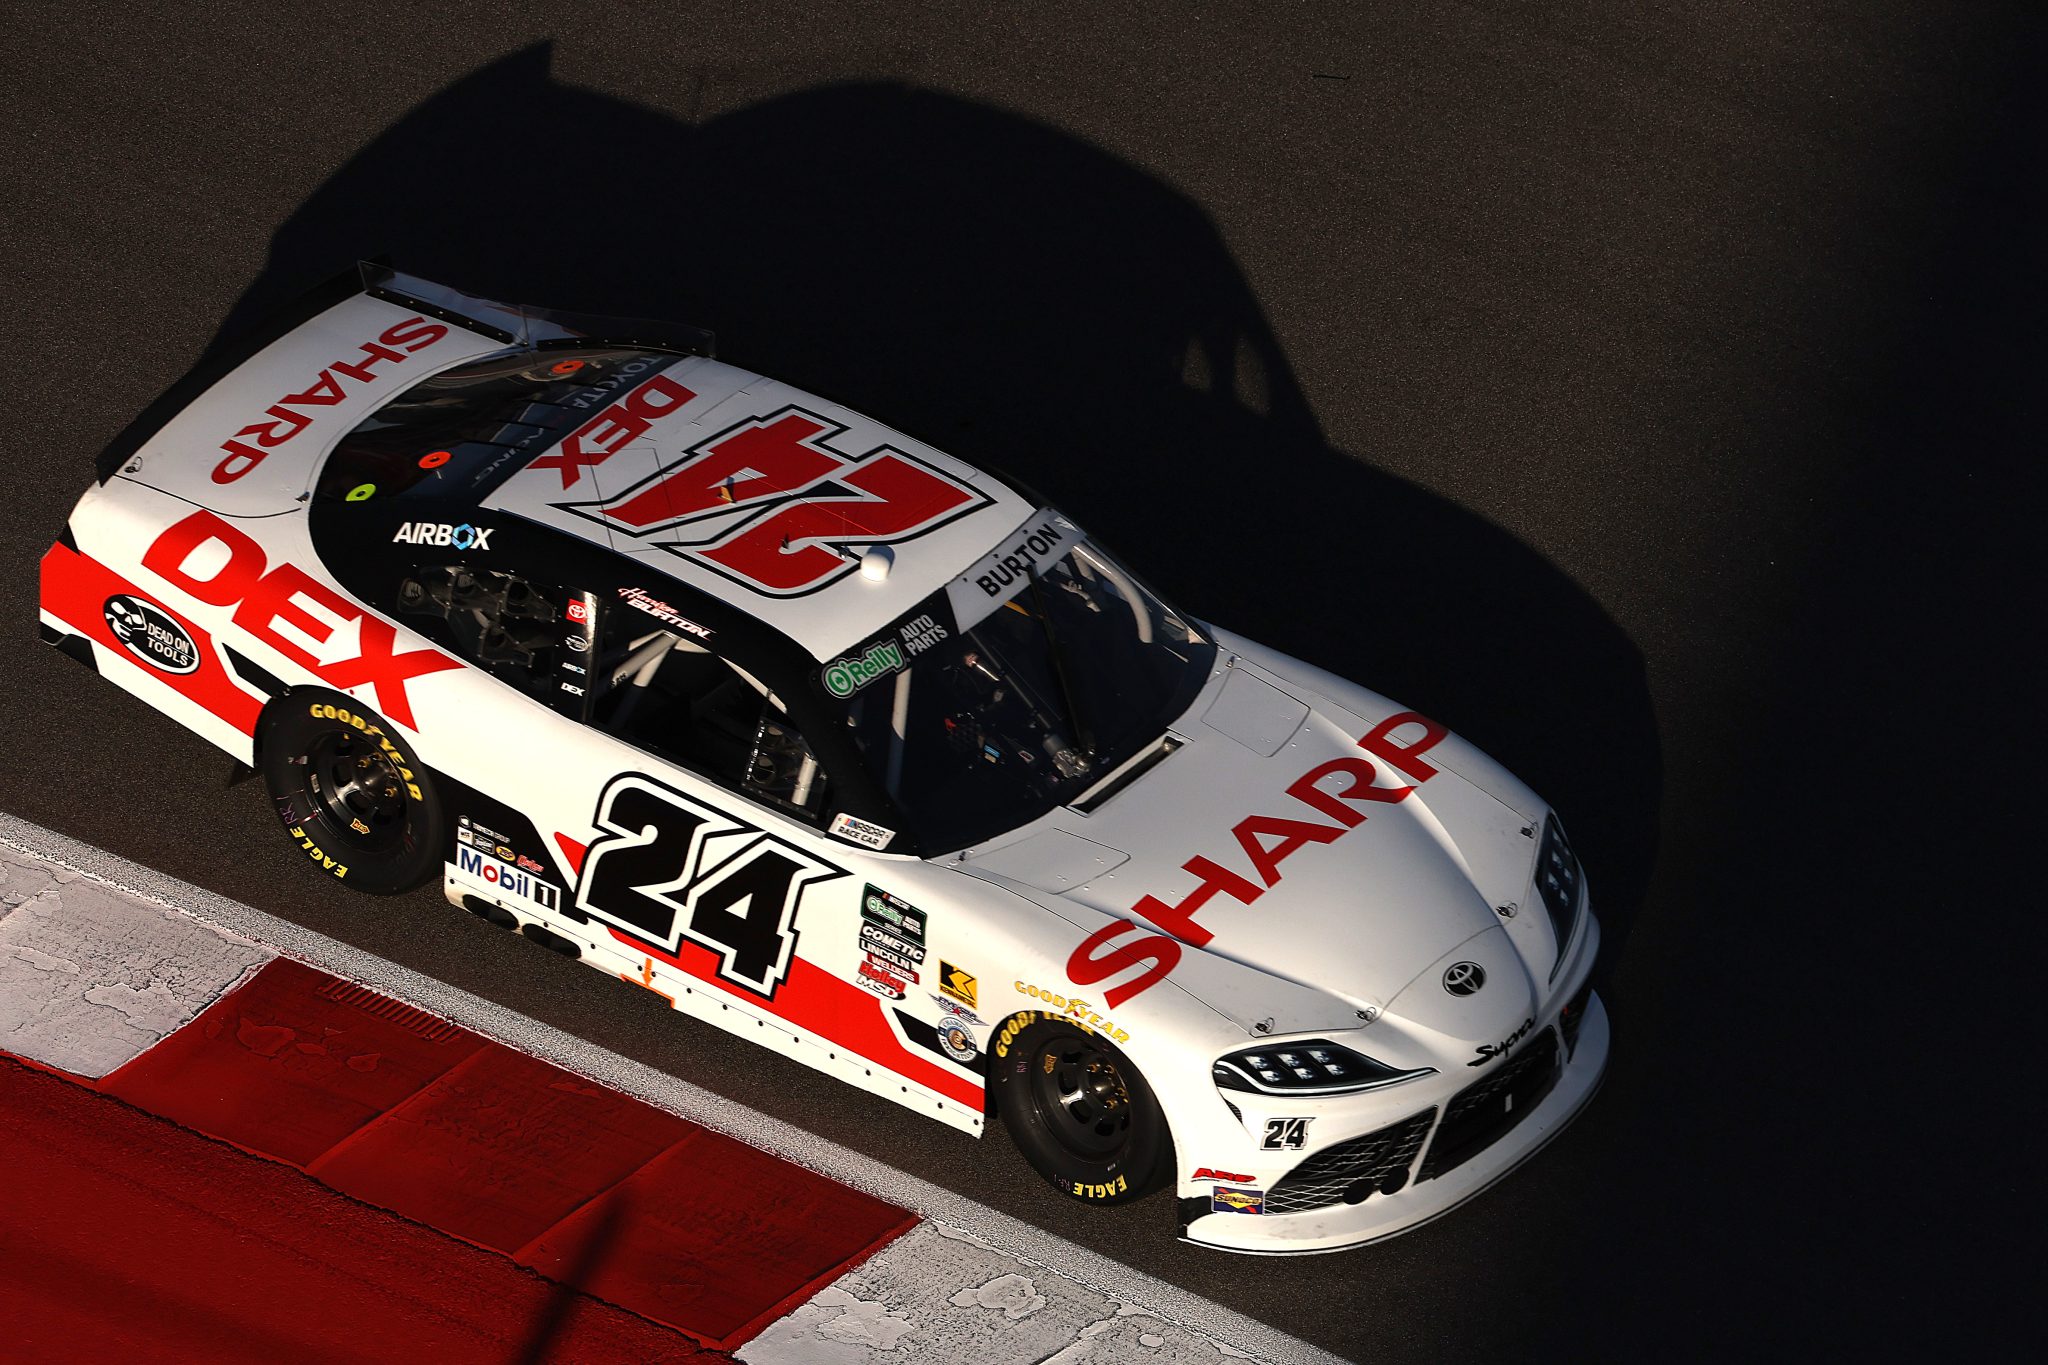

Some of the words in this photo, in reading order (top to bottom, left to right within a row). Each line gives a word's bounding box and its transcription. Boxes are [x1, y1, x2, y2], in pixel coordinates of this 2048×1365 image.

[210, 316, 449, 485] SHARP
[525, 374, 698, 490] DEX
[555, 408, 988, 597] 24
[393, 522, 495, 552] AIRBOX
[976, 523, 1063, 597] BURTON
[141, 509, 468, 733] DEX
[627, 600, 712, 638] BURTON
[900, 613, 935, 642] AUTO
[147, 622, 174, 645] DEAD
[175, 637, 190, 654] ON
[147, 637, 189, 666] TOOLS
[904, 624, 949, 656] PARTS
[825, 641, 901, 699] O'Reilly
[561, 682, 587, 696] DEX
[310, 703, 424, 802] GOODYEAR
[290, 826, 349, 878] EAGLE
[838, 826, 860, 839] RACE
[861, 835, 880, 845] CAR
[460, 847, 528, 898] Mobil
[1065, 711, 1453, 1010] SHARP
[580, 777, 845, 997] 24
[860, 940, 911, 969] LINCOLN
[862, 925, 924, 961] COMETIC
[858, 961, 907, 993] Holley
[871, 957, 915, 981] WELDERS
[856, 976, 900, 1000] MSD
[1014, 980, 1131, 1044] GOODYEAR
[1262, 1118, 1314, 1150] 24
[1073, 1174, 1128, 1198] EAGLE
[1214, 1193, 1263, 1206] SUNOCO
